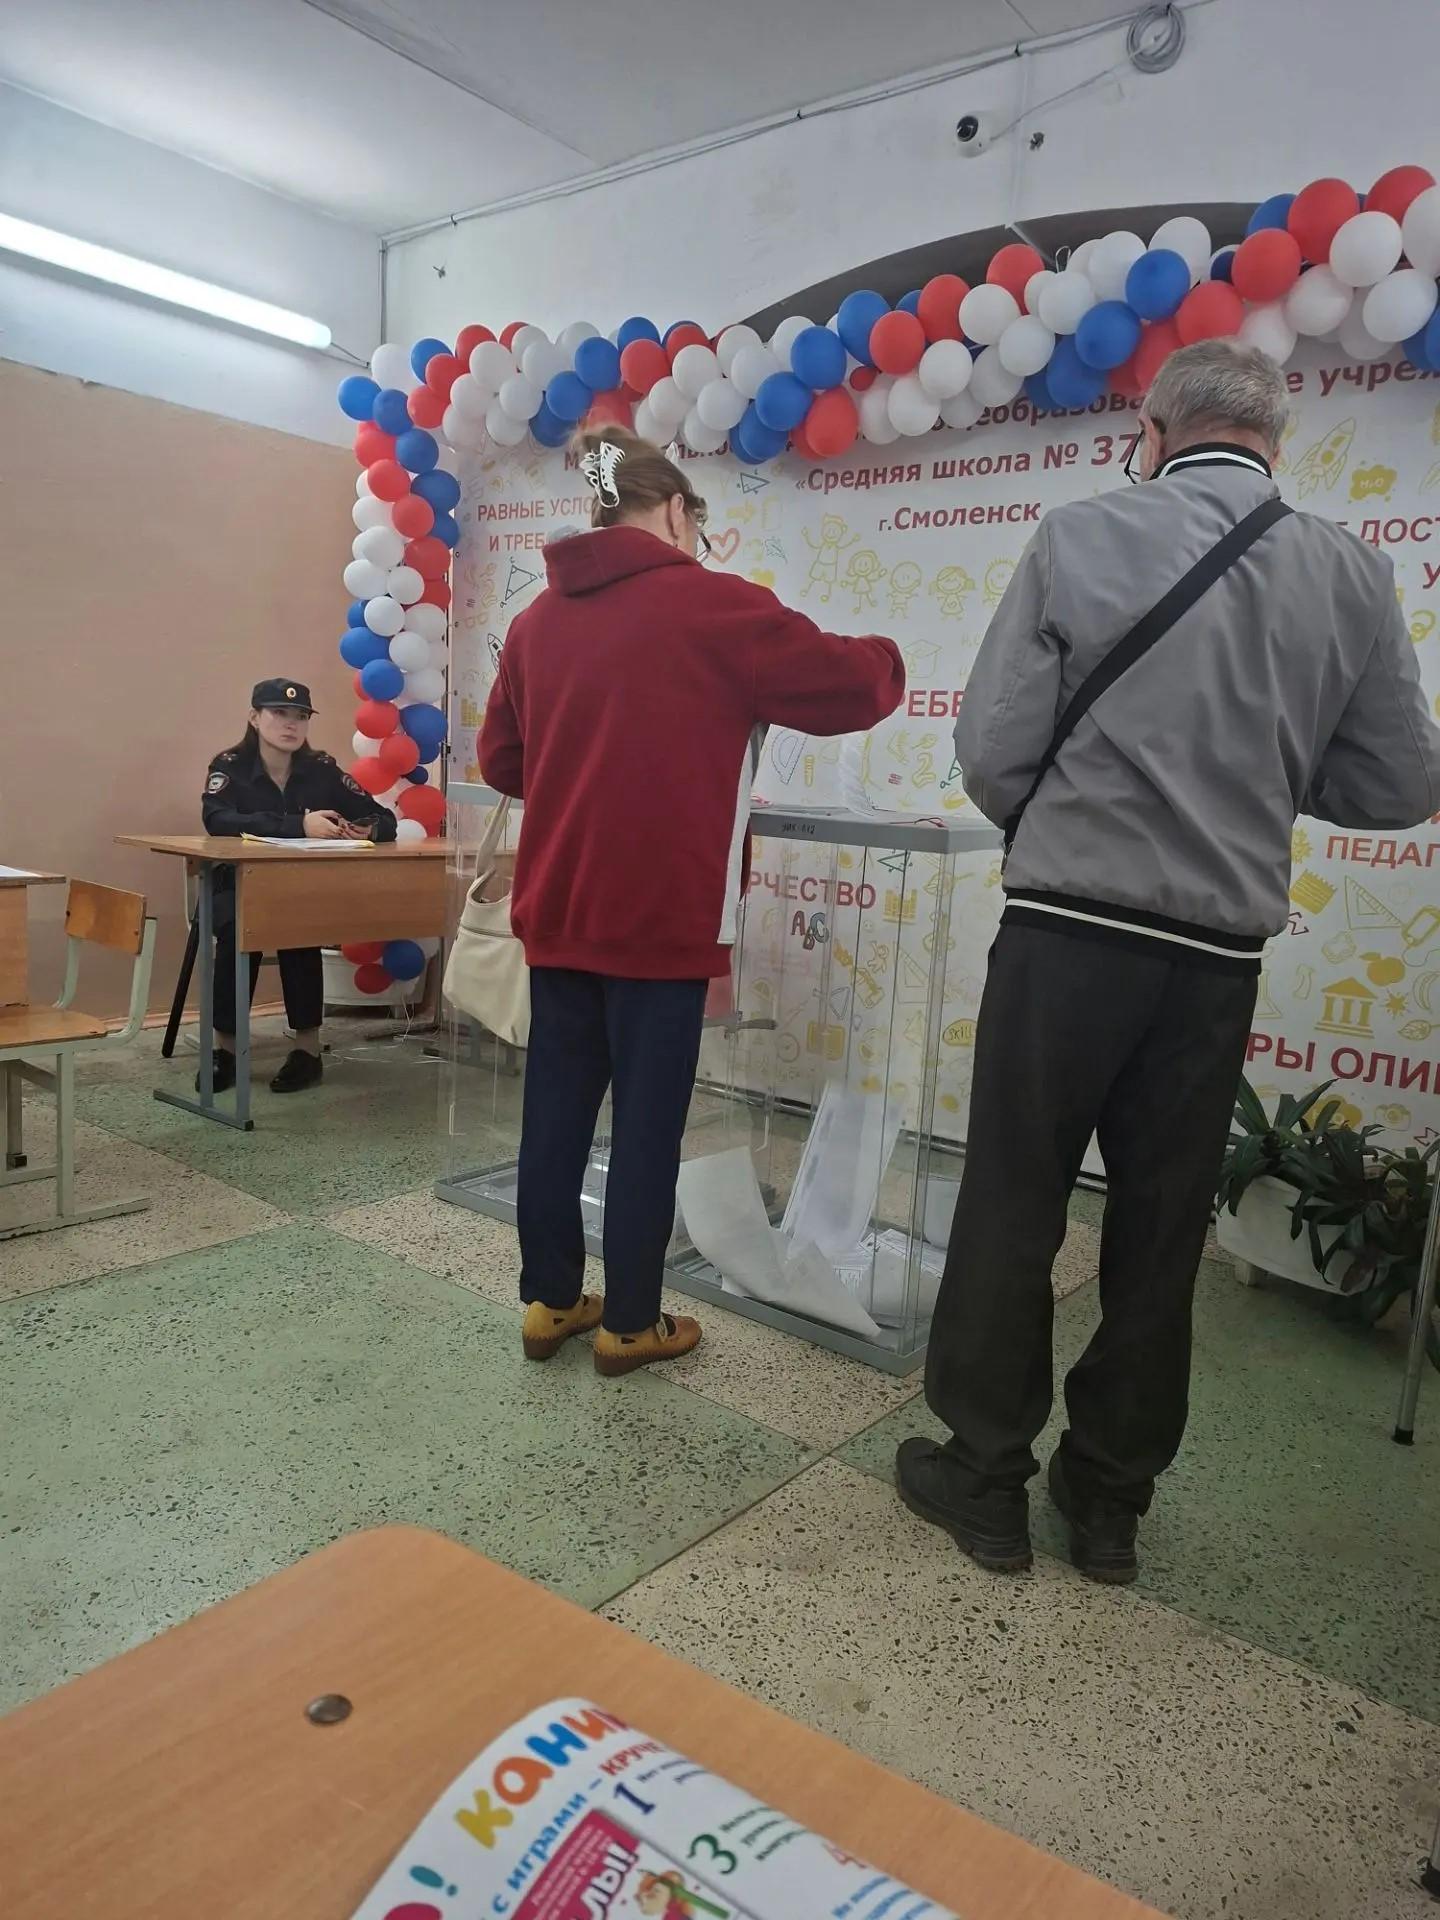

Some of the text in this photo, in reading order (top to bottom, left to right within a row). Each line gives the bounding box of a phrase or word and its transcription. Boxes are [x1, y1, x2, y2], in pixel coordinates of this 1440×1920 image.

[1318, 360, 1440, 397] учре
[932, 452, 1031, 479] школа
[1043, 442, 1080, 470] №
[477, 500, 545, 522] РАВНЫЕ
[489, 535, 500, 553] И
[1331, 1047, 1440, 1095] ОЛИ
[686, 1833, 738, 1875] 3
